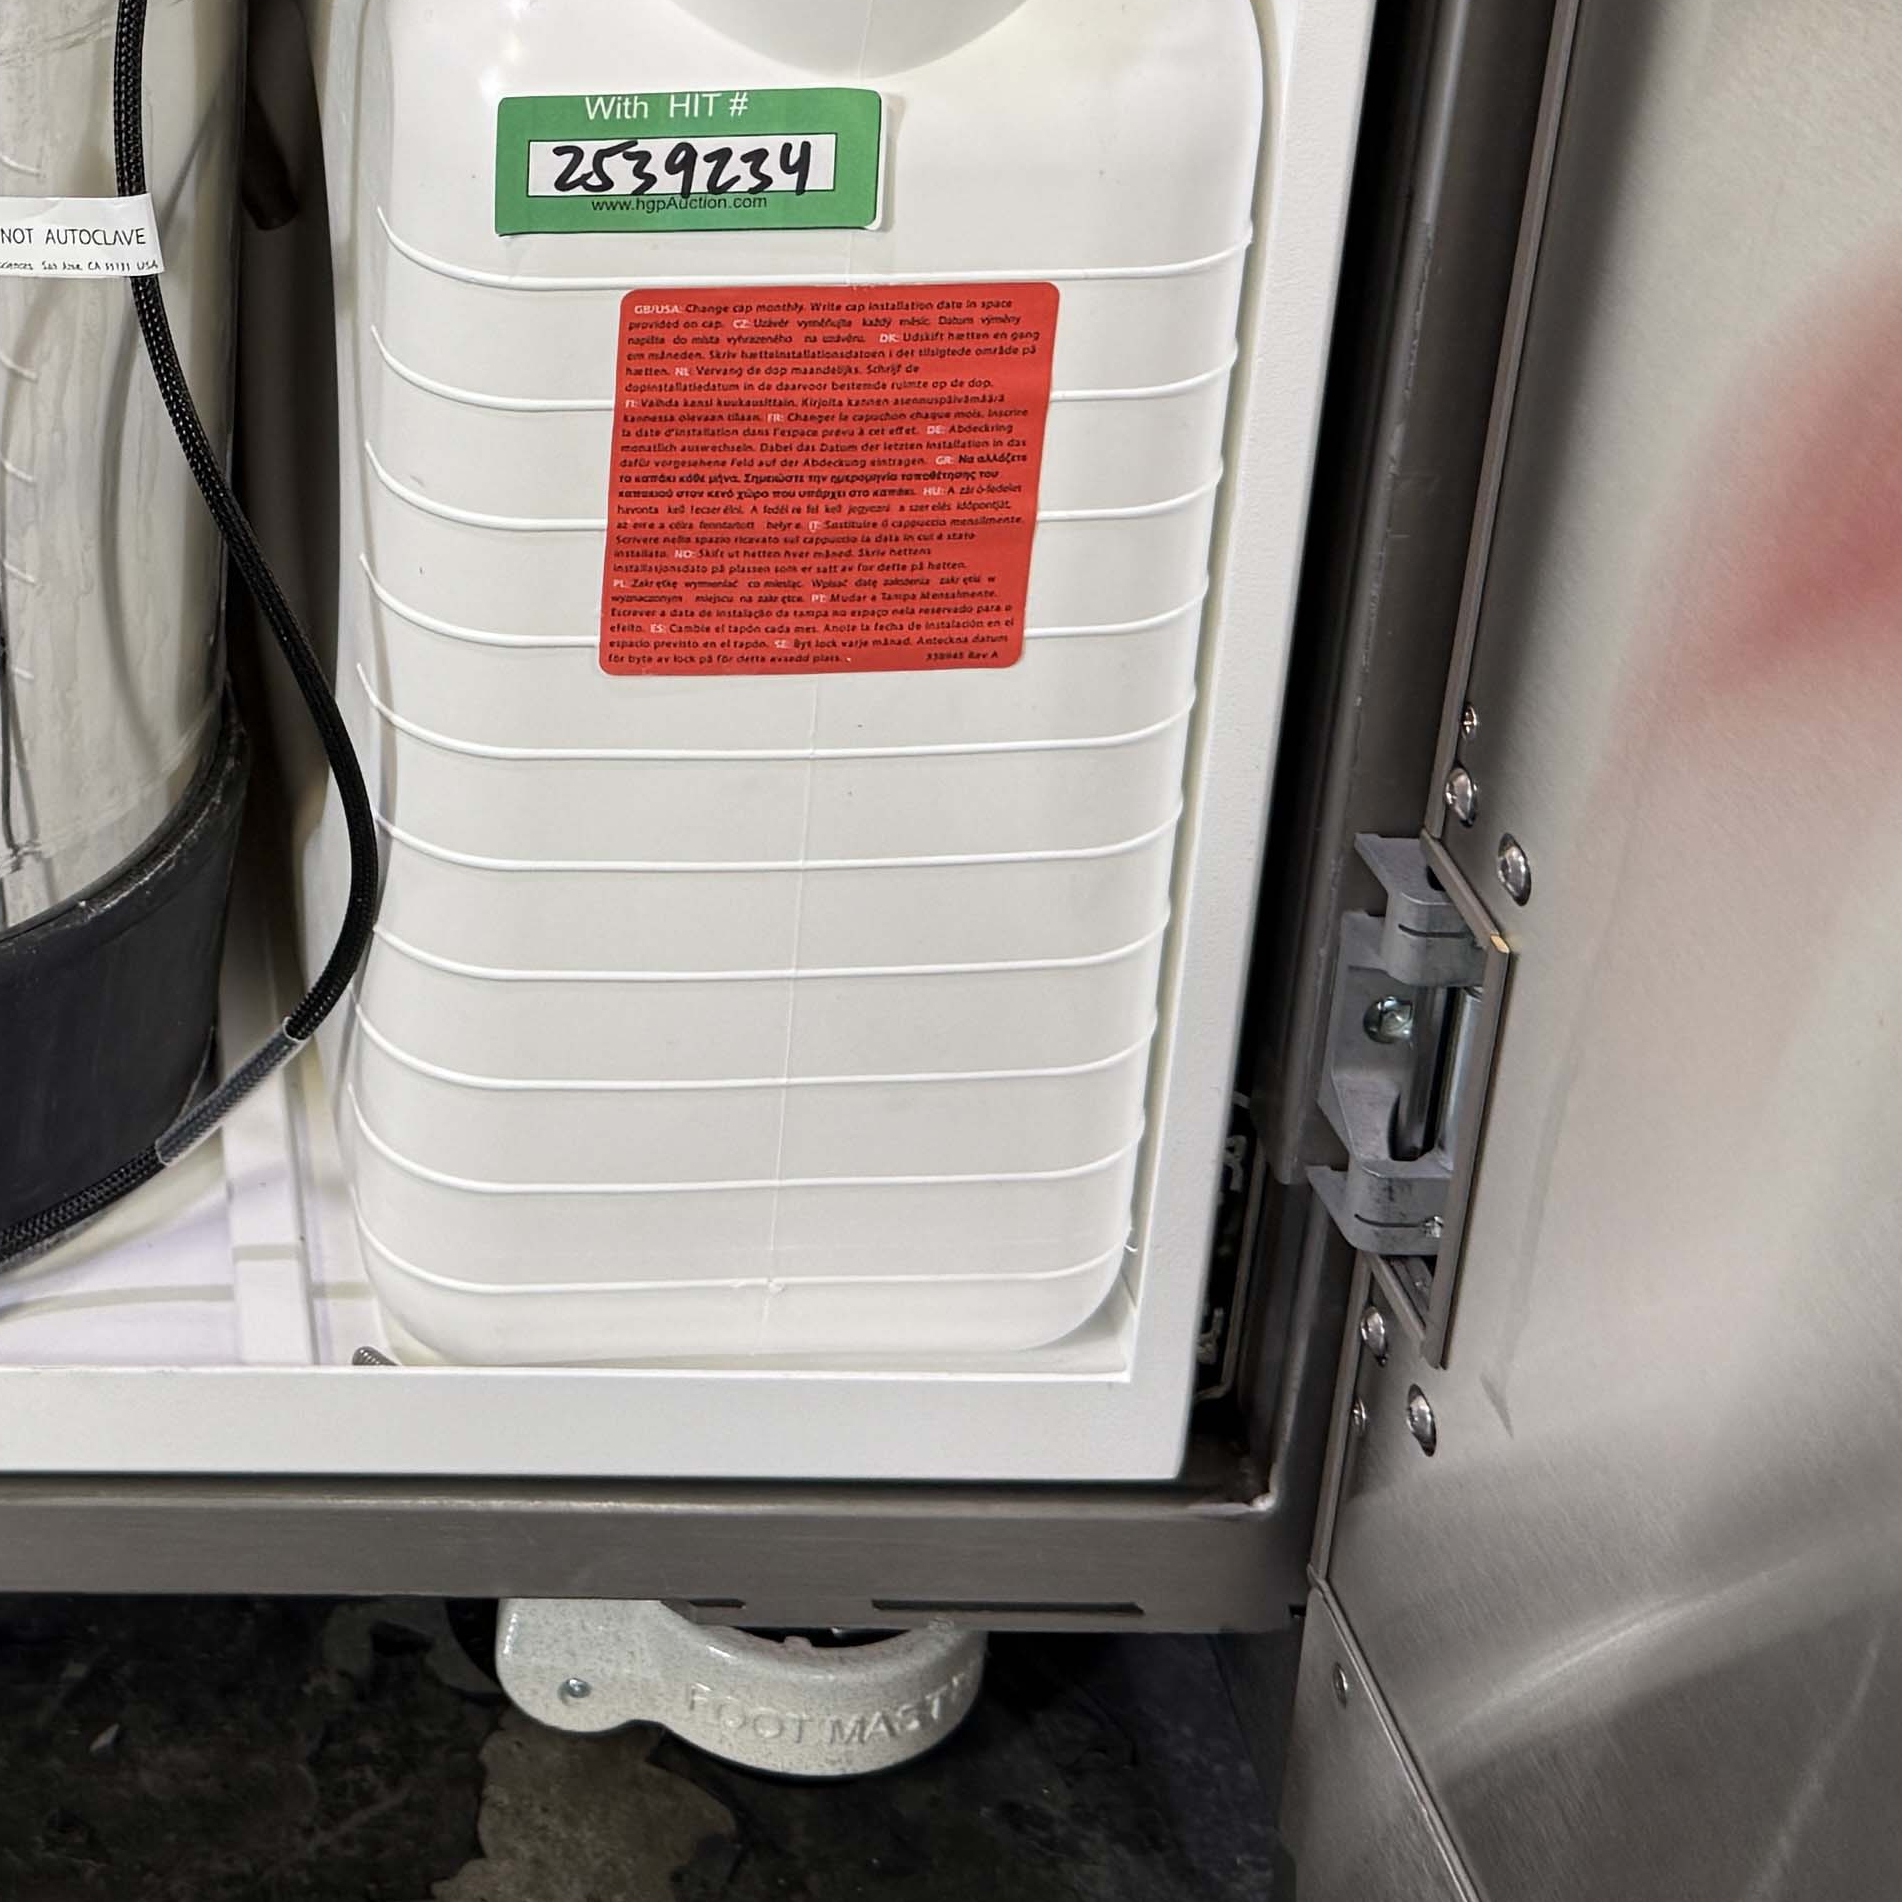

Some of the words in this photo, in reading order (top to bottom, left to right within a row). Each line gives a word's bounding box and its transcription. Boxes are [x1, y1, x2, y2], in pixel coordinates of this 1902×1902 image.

[585, 95, 648, 120] With
[670, 93, 721, 118] HIT
[729, 92, 748, 117] #
[552, 140, 811, 198] 2539234
[591, 194, 767, 214] www.hgpAuction.com
[0, 227, 34, 244] NOT
[45, 227, 146, 245] AUTOCLAVE
[685, 302, 729, 314] Change
[733, 304, 753, 315] cap
[756, 301, 804, 313] monthly.
[810, 301, 842, 312] Write
[846, 303, 865, 314] cap
[869, 300, 933, 311] installation
[937, 300, 962, 310] date
[966, 299, 977, 308] in
[981, 300, 1012, 312] space
[628, 320, 678, 331] provided
[684, 320, 697, 328] on
